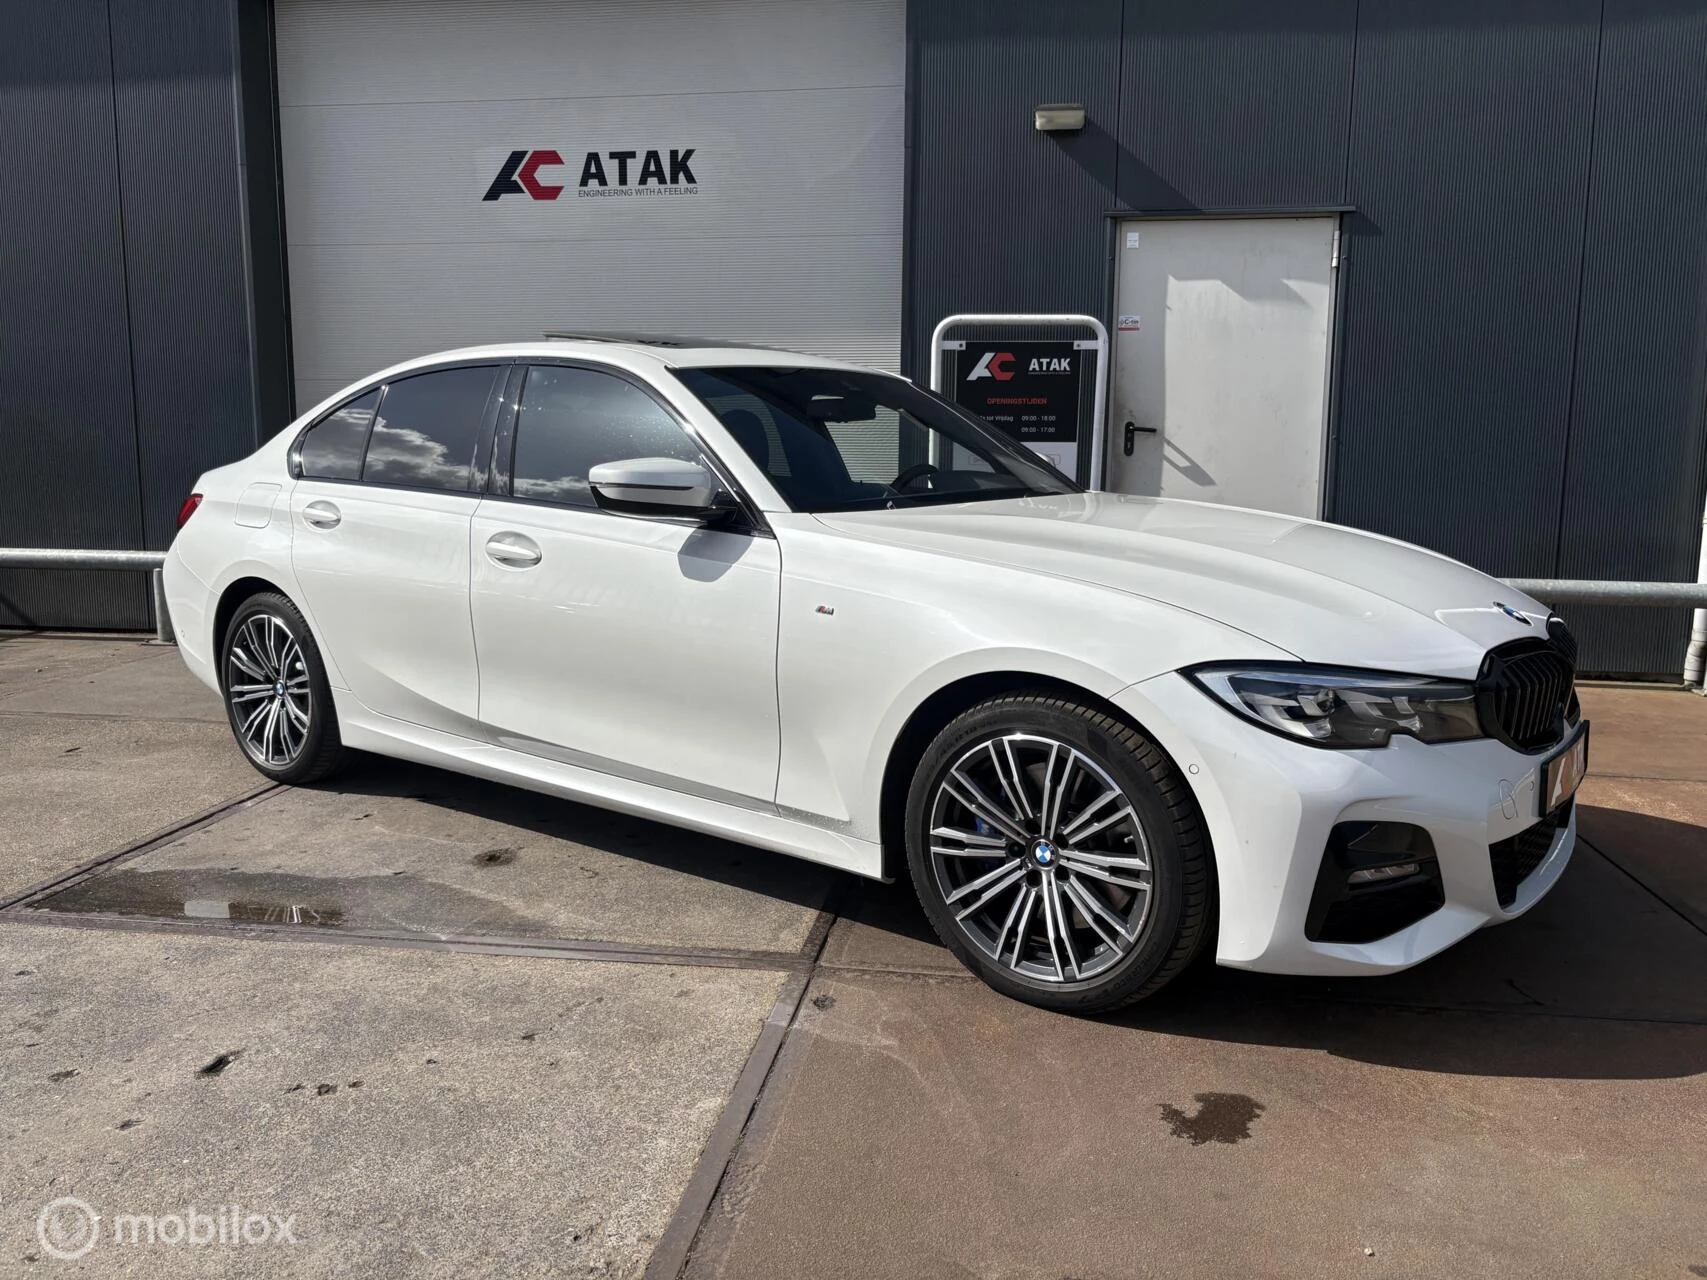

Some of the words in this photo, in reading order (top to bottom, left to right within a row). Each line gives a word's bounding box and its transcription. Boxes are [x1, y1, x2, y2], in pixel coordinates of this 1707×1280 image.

[579, 149, 698, 187] ATAK
[578, 189, 633, 198] ENGINEERING
[634, 188, 655, 197] WITH
[664, 187, 699, 196] FEELING
[1029, 358, 1071, 371] ATAK
